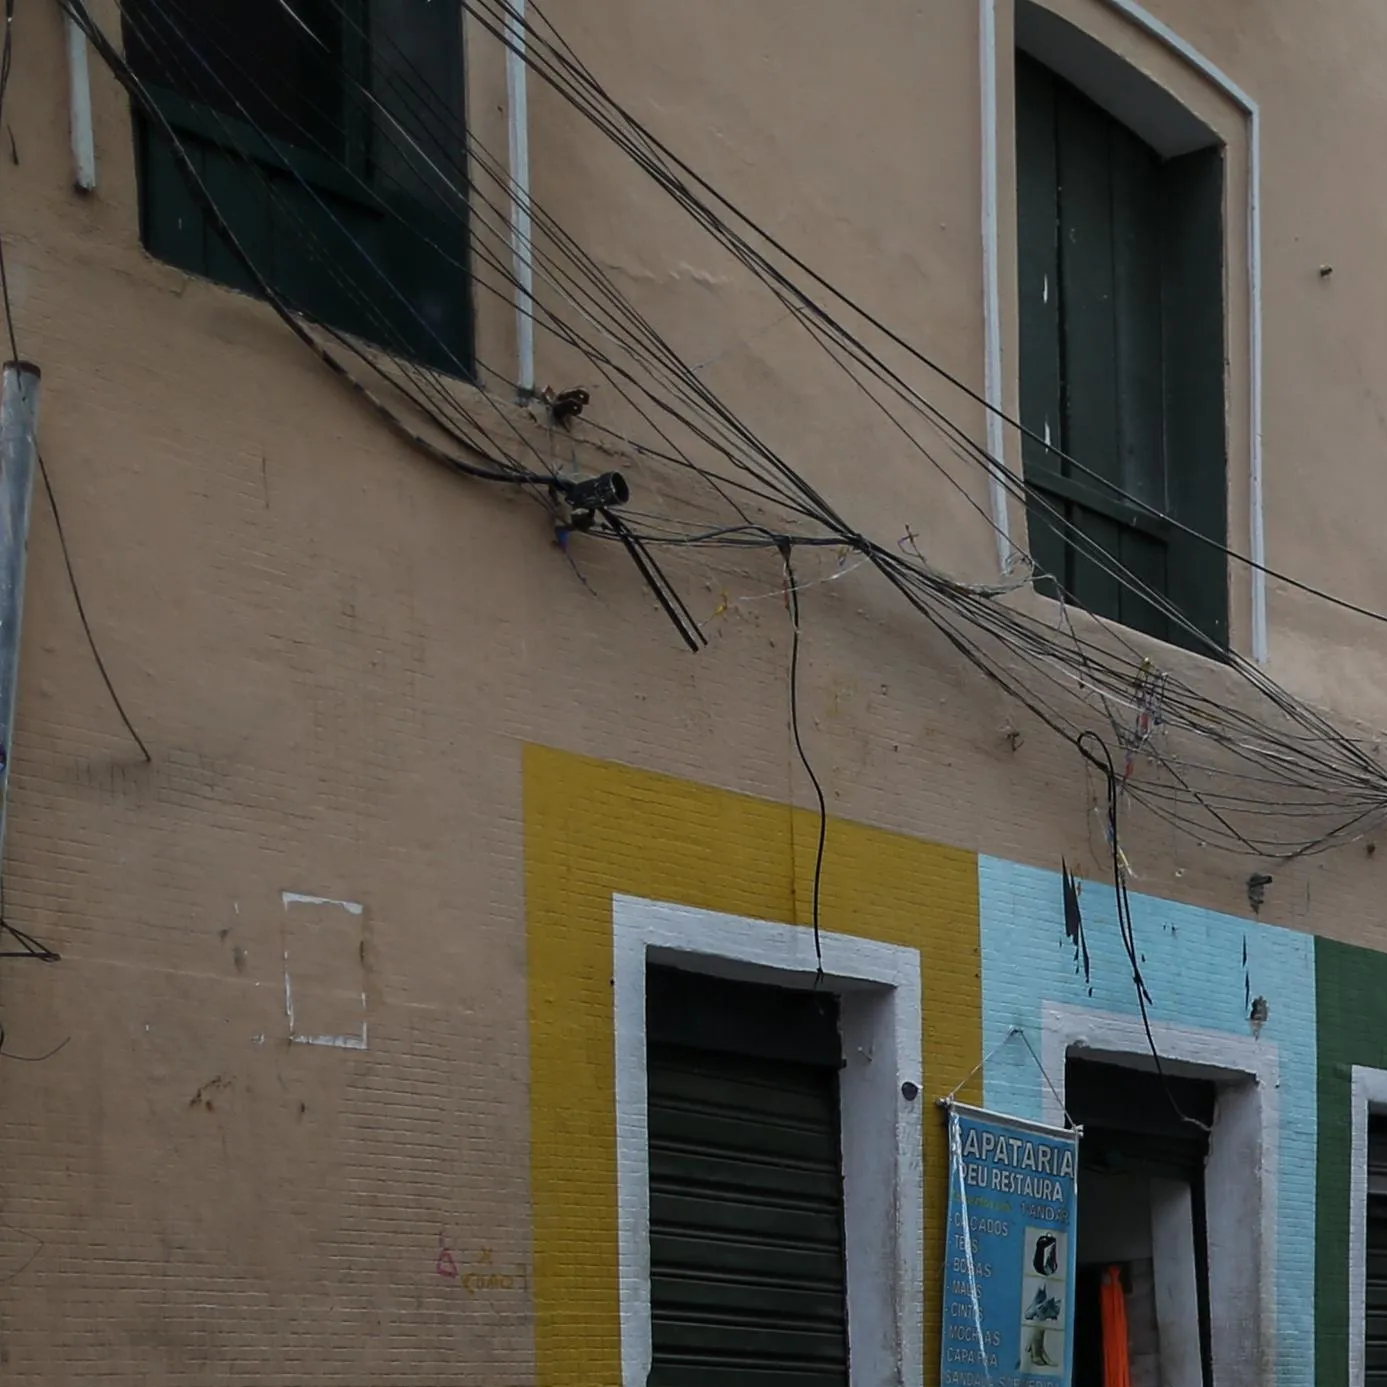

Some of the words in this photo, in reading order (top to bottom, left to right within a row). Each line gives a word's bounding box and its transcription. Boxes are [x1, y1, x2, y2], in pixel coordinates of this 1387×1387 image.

[955, 1128, 1075, 1178] APATARIA
[991, 1166, 1064, 1202] RESTAURA
[952, 1256, 992, 1278] BOAS
[952, 1279, 983, 1299] MALS
[948, 1324, 1001, 1347] MOCHAS
